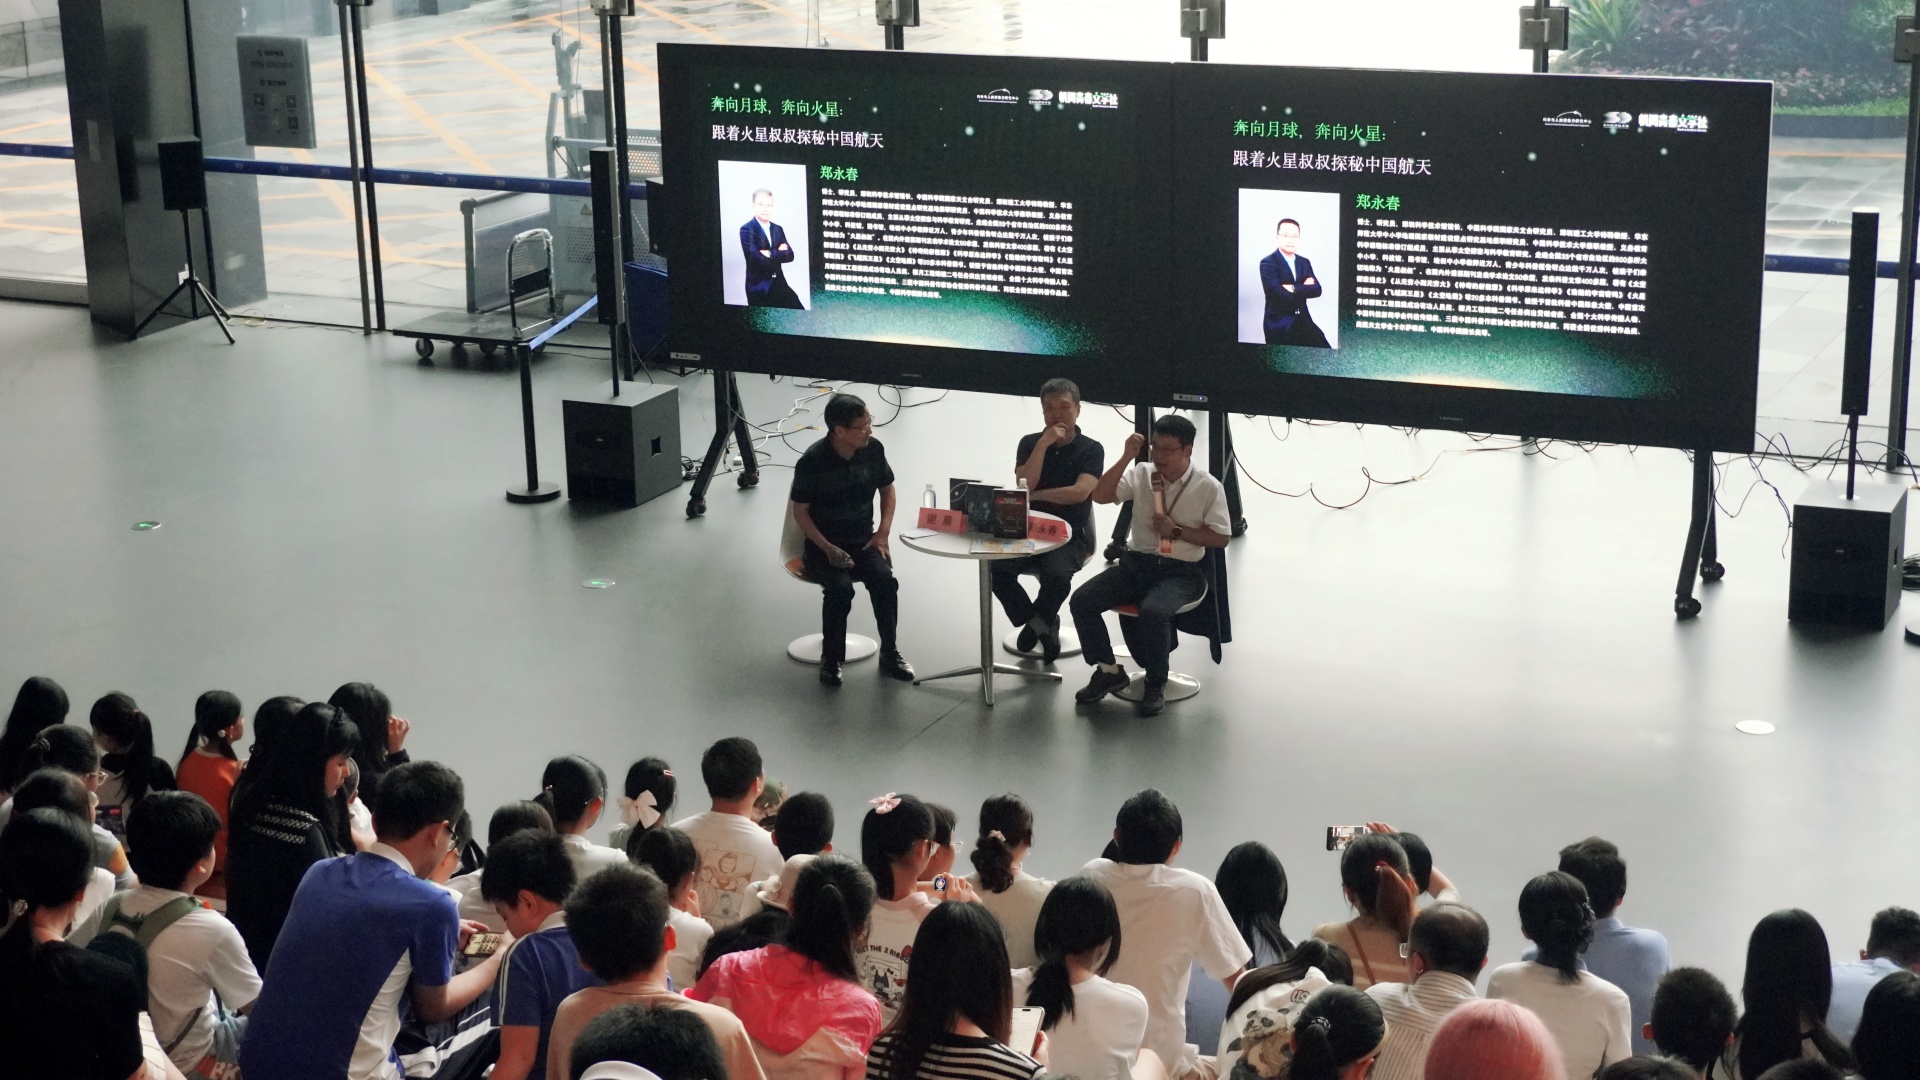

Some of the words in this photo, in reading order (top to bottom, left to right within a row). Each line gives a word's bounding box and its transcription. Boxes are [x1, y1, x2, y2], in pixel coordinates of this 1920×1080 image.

[711, 124, 885, 149] 跟着火星叔叔探秘中国航天
[1233, 149, 1432, 176] 跟着火星叔叔探秘中国航天
[819, 165, 859, 182] 郑永春
[1355, 193, 1401, 212] 郑永春
[870, 945, 882, 953] THE
